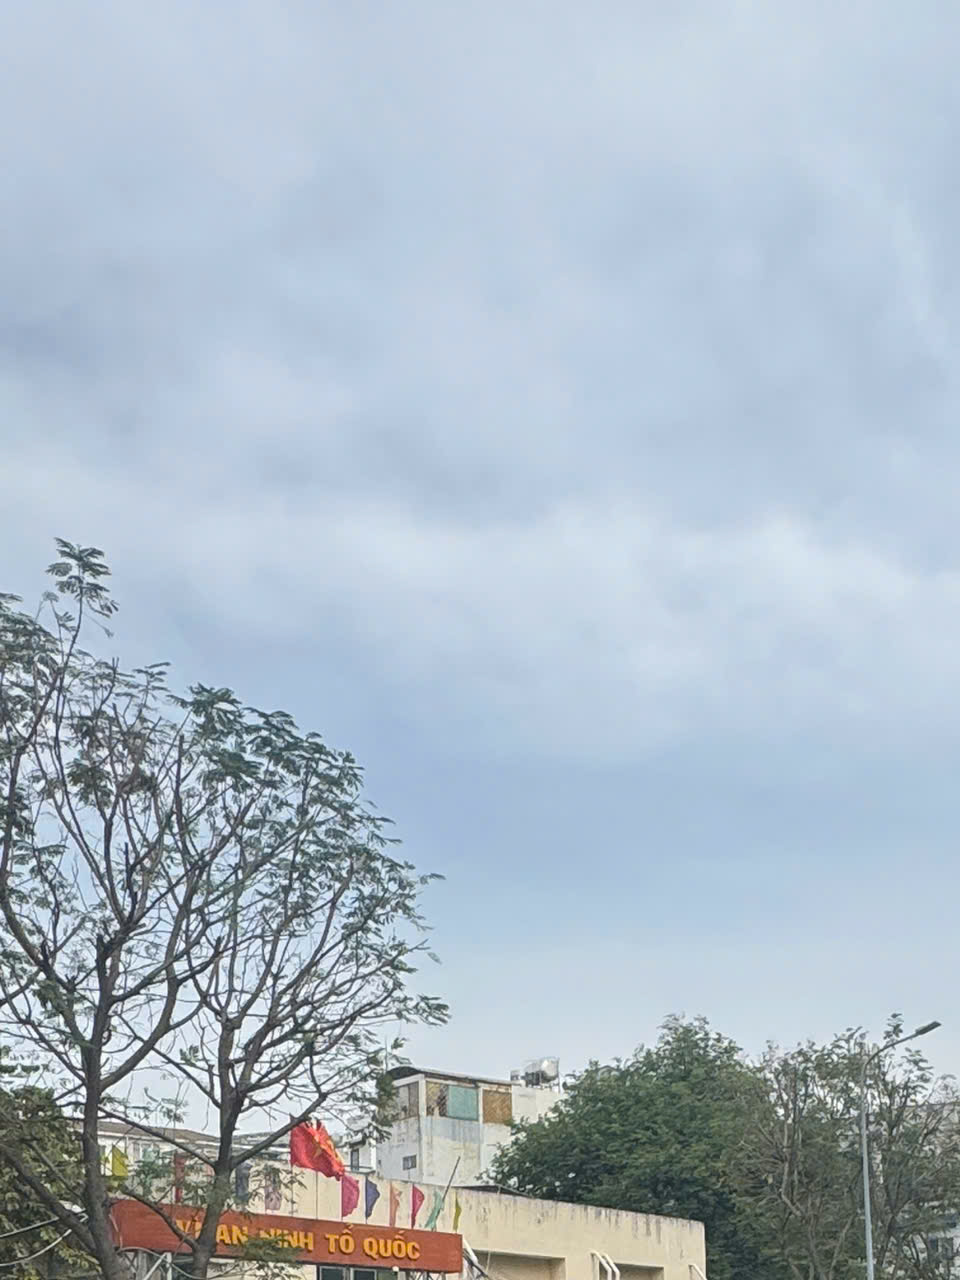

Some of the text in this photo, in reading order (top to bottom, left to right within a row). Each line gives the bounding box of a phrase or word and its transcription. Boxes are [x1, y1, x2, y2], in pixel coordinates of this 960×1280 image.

[215, 1223, 249, 1246] AN
[325, 1222, 355, 1254] TỔ
[363, 1230, 421, 1261] QUỐC
